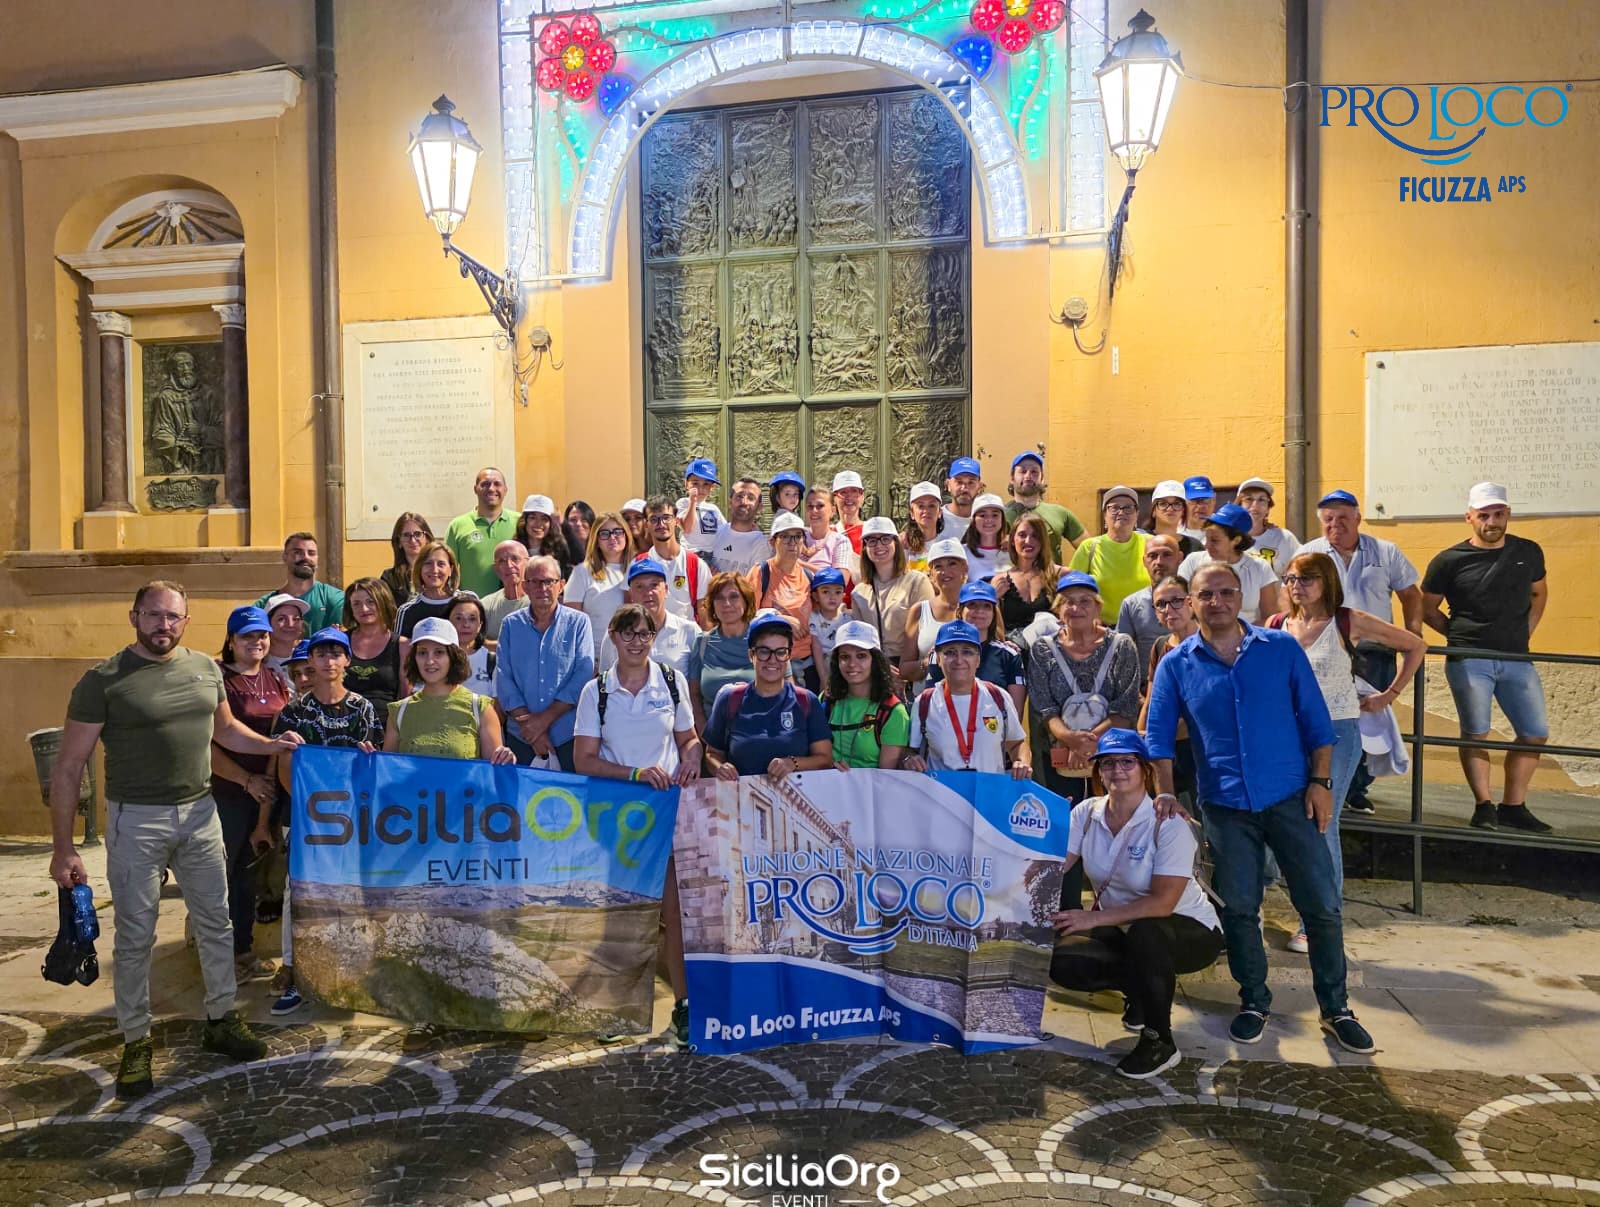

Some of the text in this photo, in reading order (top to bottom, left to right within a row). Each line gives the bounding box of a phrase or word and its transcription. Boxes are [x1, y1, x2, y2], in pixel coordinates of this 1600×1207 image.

[303, 786, 656, 869] SiciliaOrg
[1010, 815, 1049, 829] UNPLI
[427, 858, 529, 881] EVENTI
[743, 847, 993, 879] UNIONE NAZIONALE
[745, 872, 986, 929] PRO LOCO
[908, 924, 979, 952] D'ITALIA
